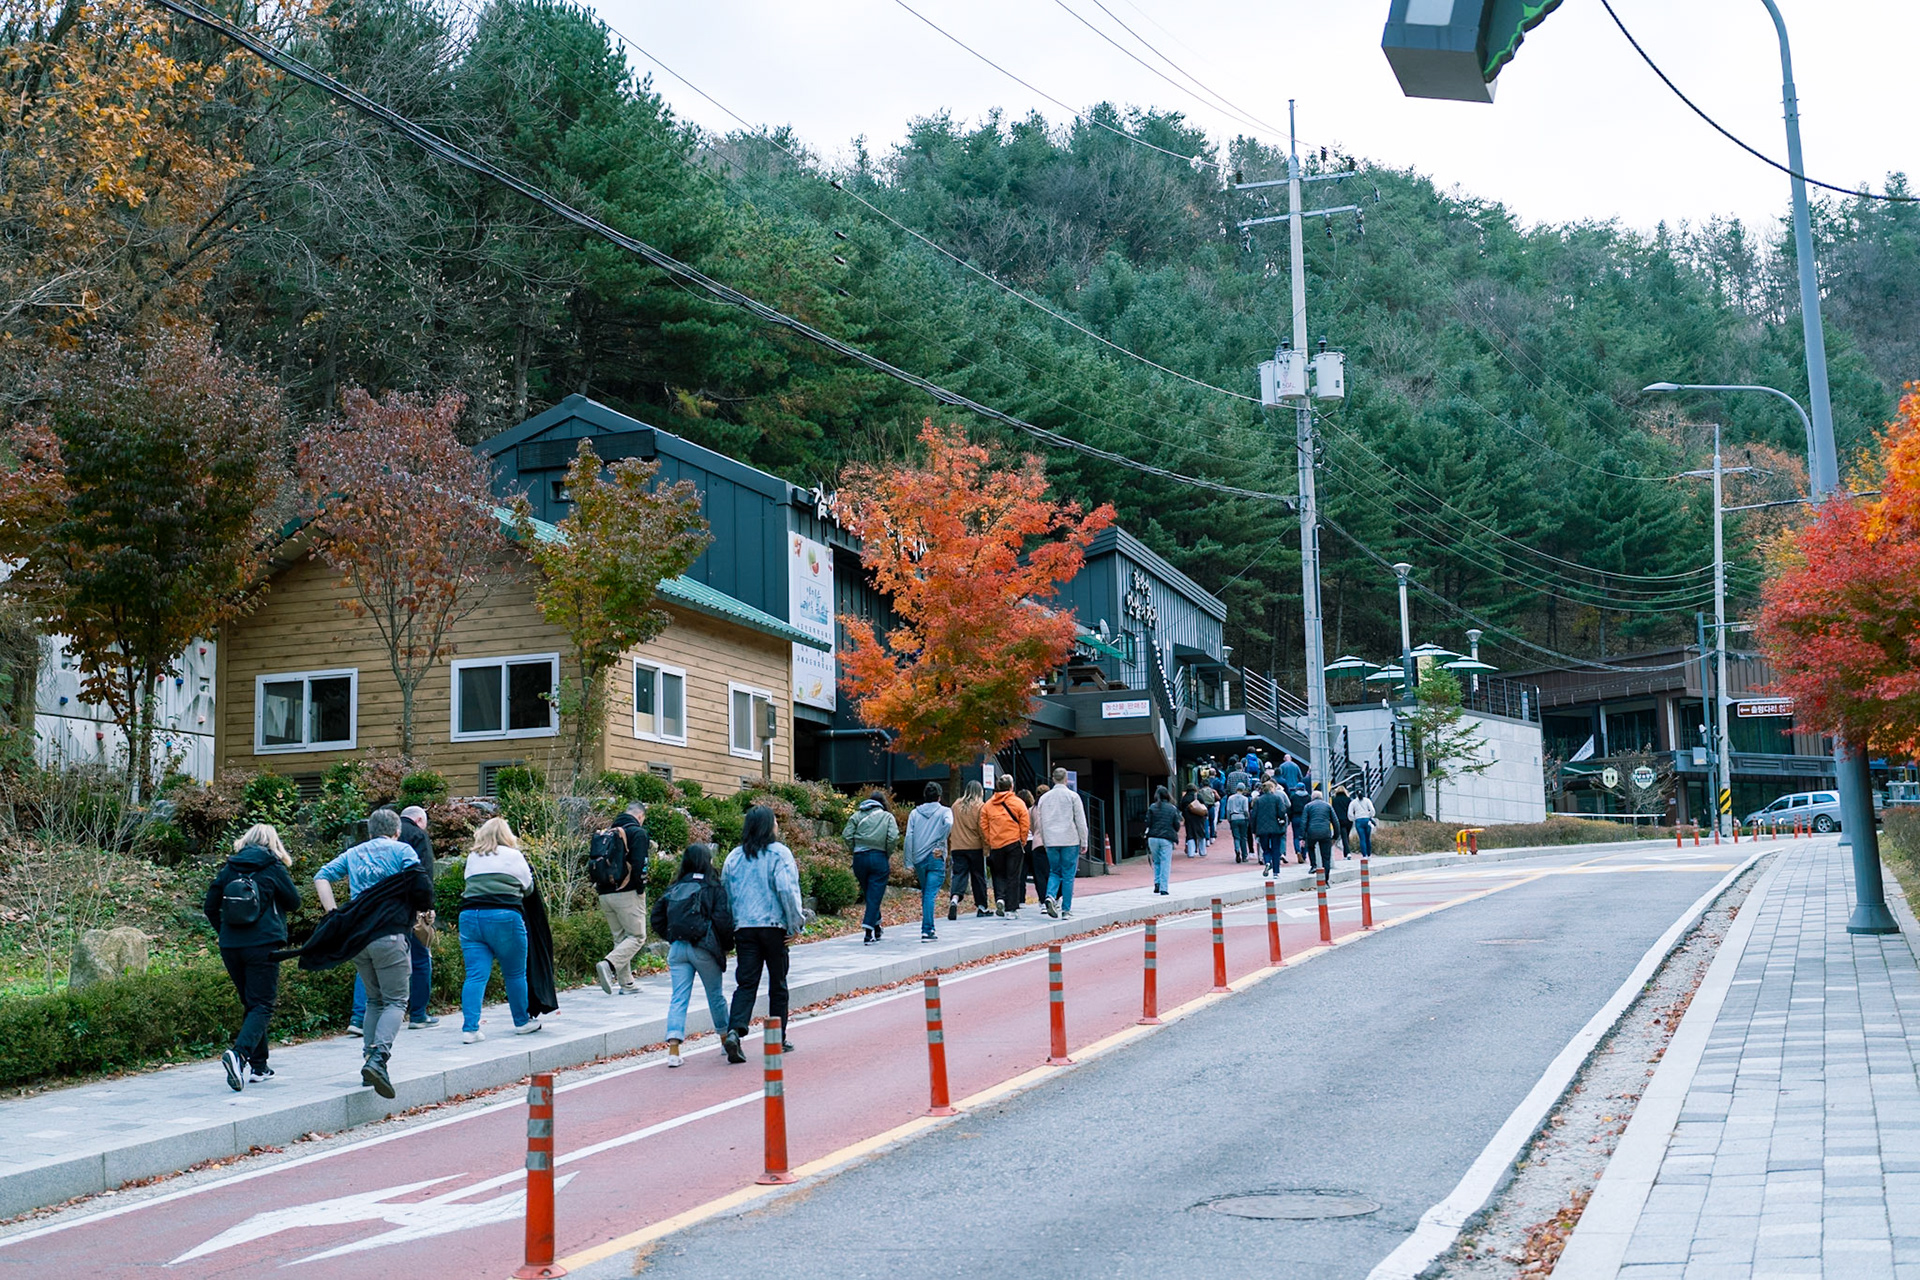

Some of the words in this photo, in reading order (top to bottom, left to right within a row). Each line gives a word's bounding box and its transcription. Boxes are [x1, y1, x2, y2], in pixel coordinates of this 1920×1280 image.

[1105, 702, 1125, 711] 농산물
[1127, 701, 1147, 710] 판매장
[1751, 704, 1778, 714] 출렁다리
